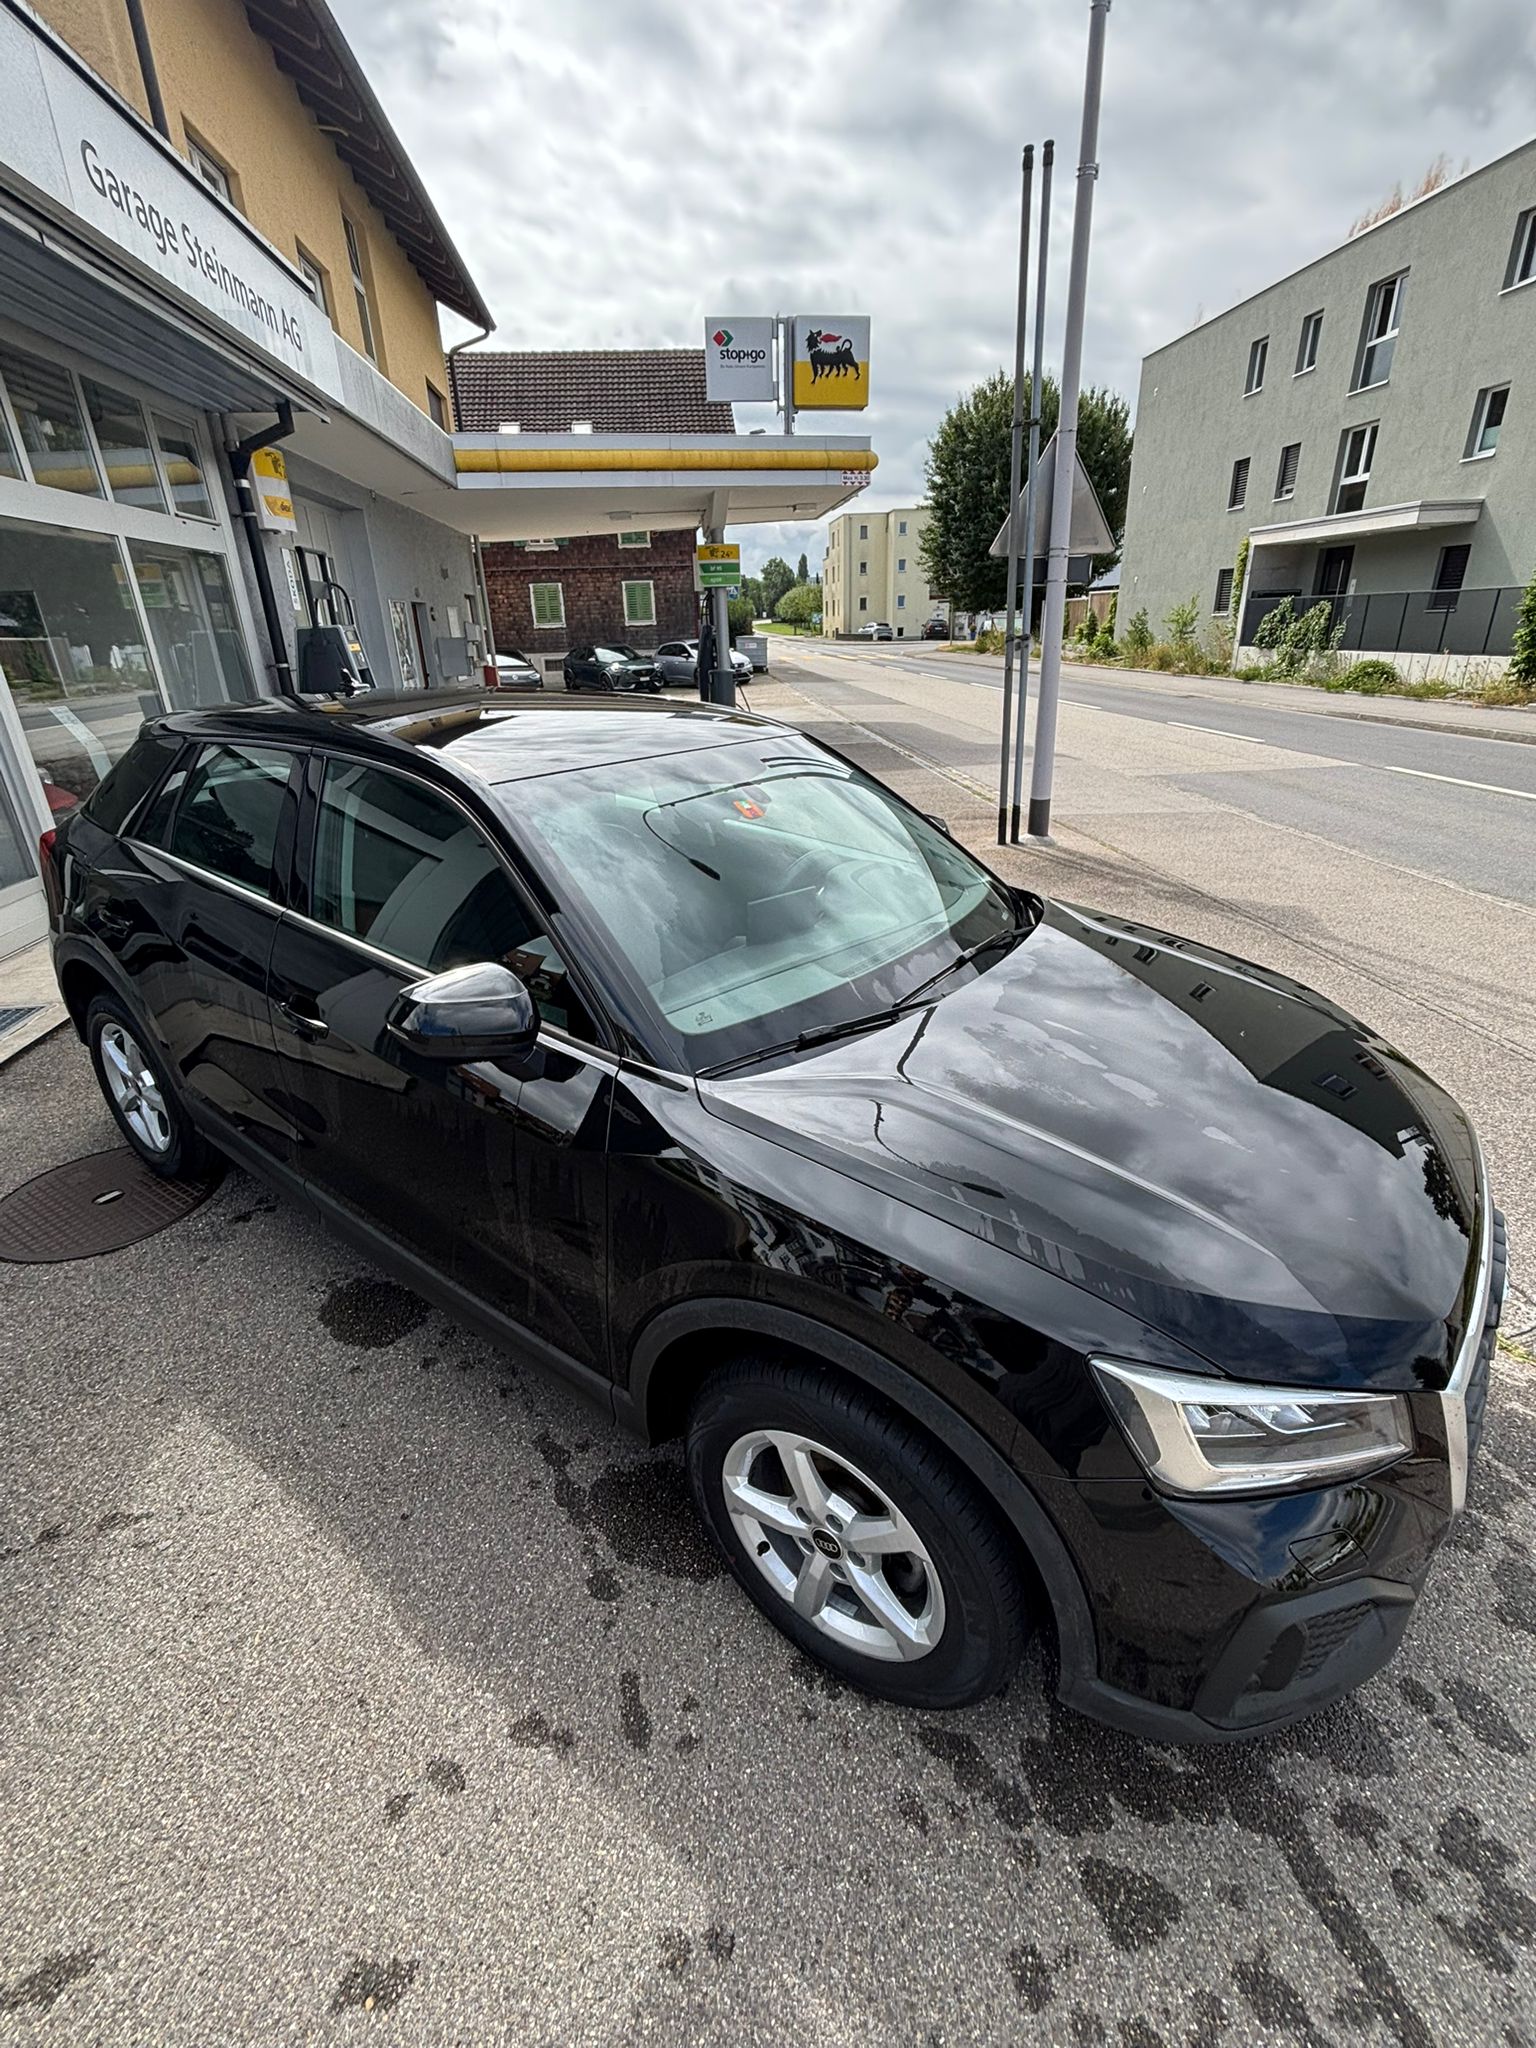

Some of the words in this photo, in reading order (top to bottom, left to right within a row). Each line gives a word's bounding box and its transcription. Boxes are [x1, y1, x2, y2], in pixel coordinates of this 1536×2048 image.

[81, 139, 179, 256] Garage
[182, 222, 280, 334] Steinmann
[281, 307, 303, 352] AG
[719, 347, 766, 363] stop+go
